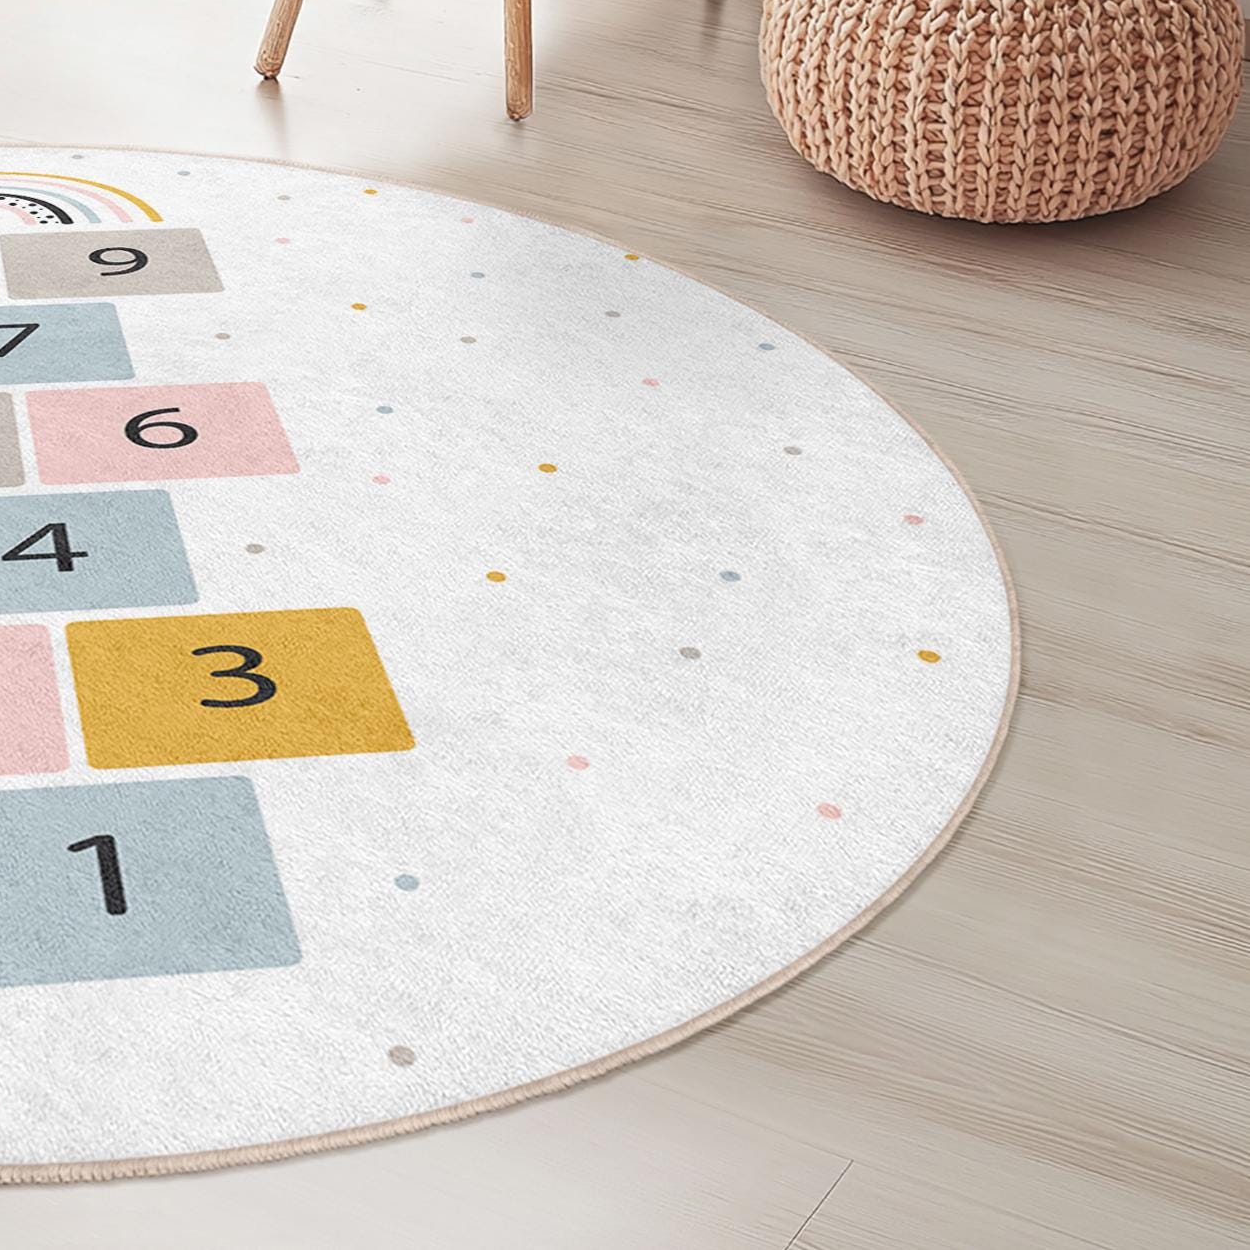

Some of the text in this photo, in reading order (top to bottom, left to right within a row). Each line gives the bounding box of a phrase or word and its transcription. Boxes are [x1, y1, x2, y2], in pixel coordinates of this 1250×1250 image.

[89, 247, 148, 276] 9
[124, 407, 198, 449] 6
[1, 522, 88, 572] 4
[192, 645, 277, 708] 3
[67, 834, 127, 916] 1
